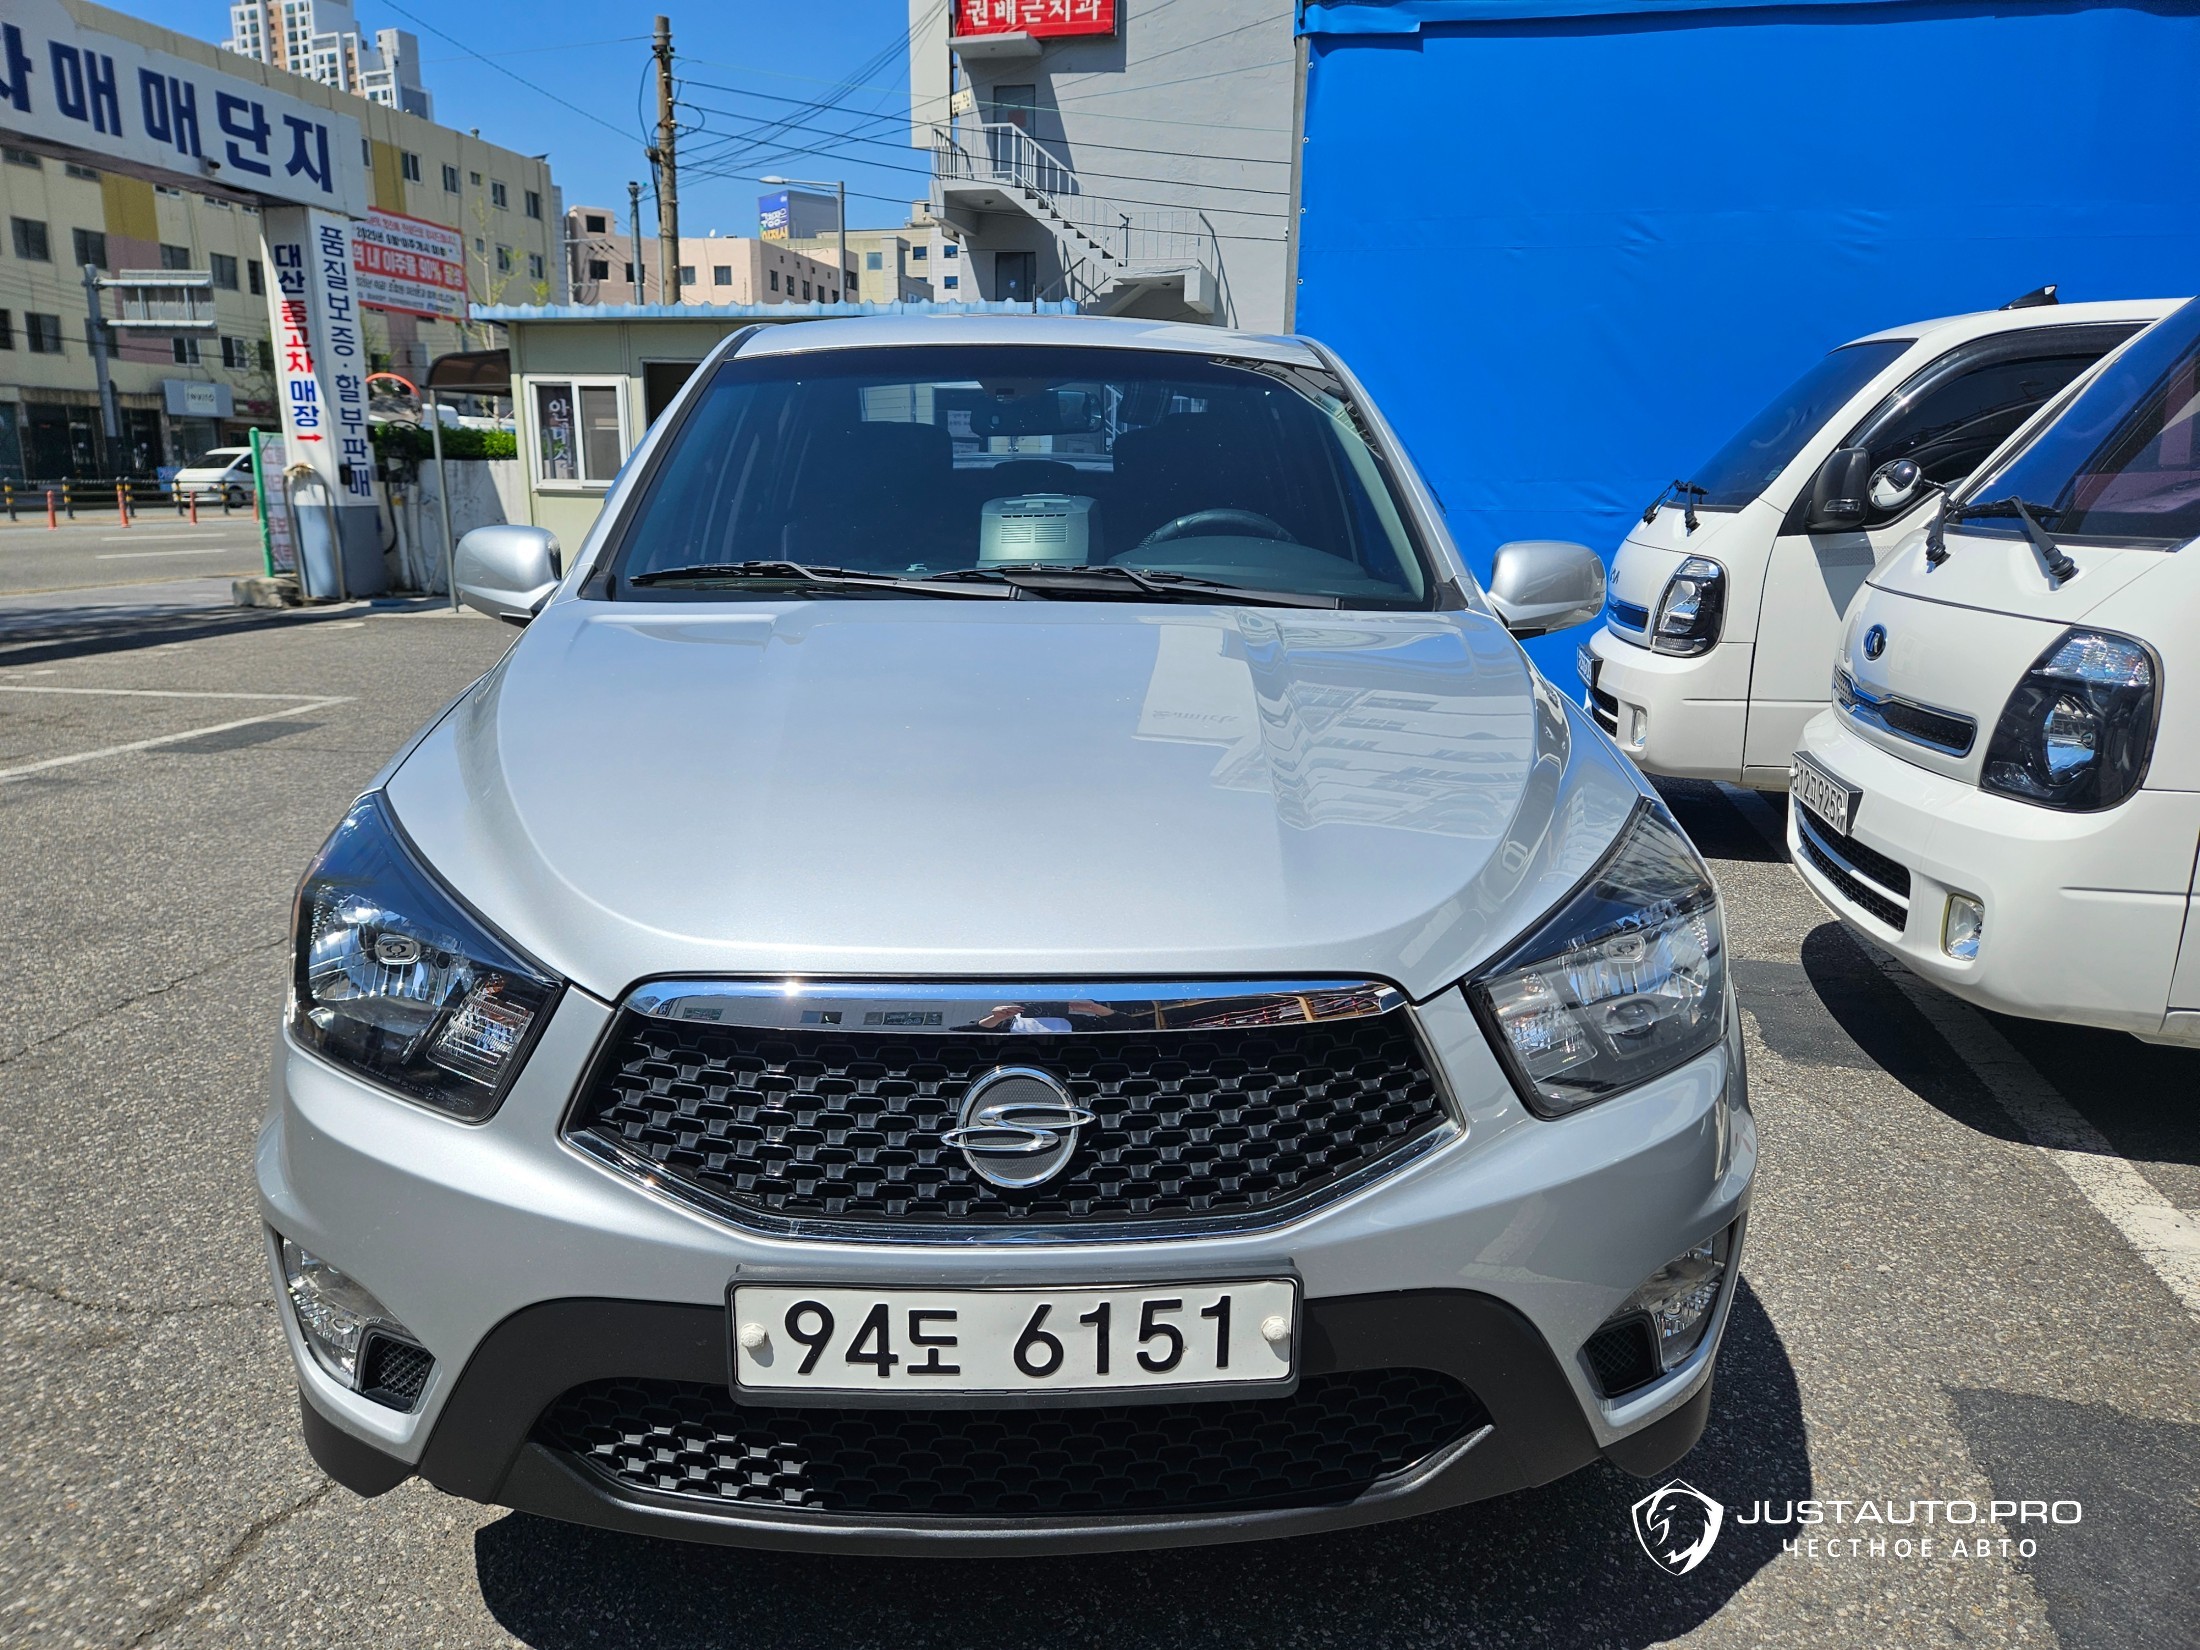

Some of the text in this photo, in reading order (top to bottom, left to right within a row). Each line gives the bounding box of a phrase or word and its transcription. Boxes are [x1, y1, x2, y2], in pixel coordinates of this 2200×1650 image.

[274, 244, 320, 427] 대산 중고차 매장
[784, 1294, 1232, 1378] 94도 6151
